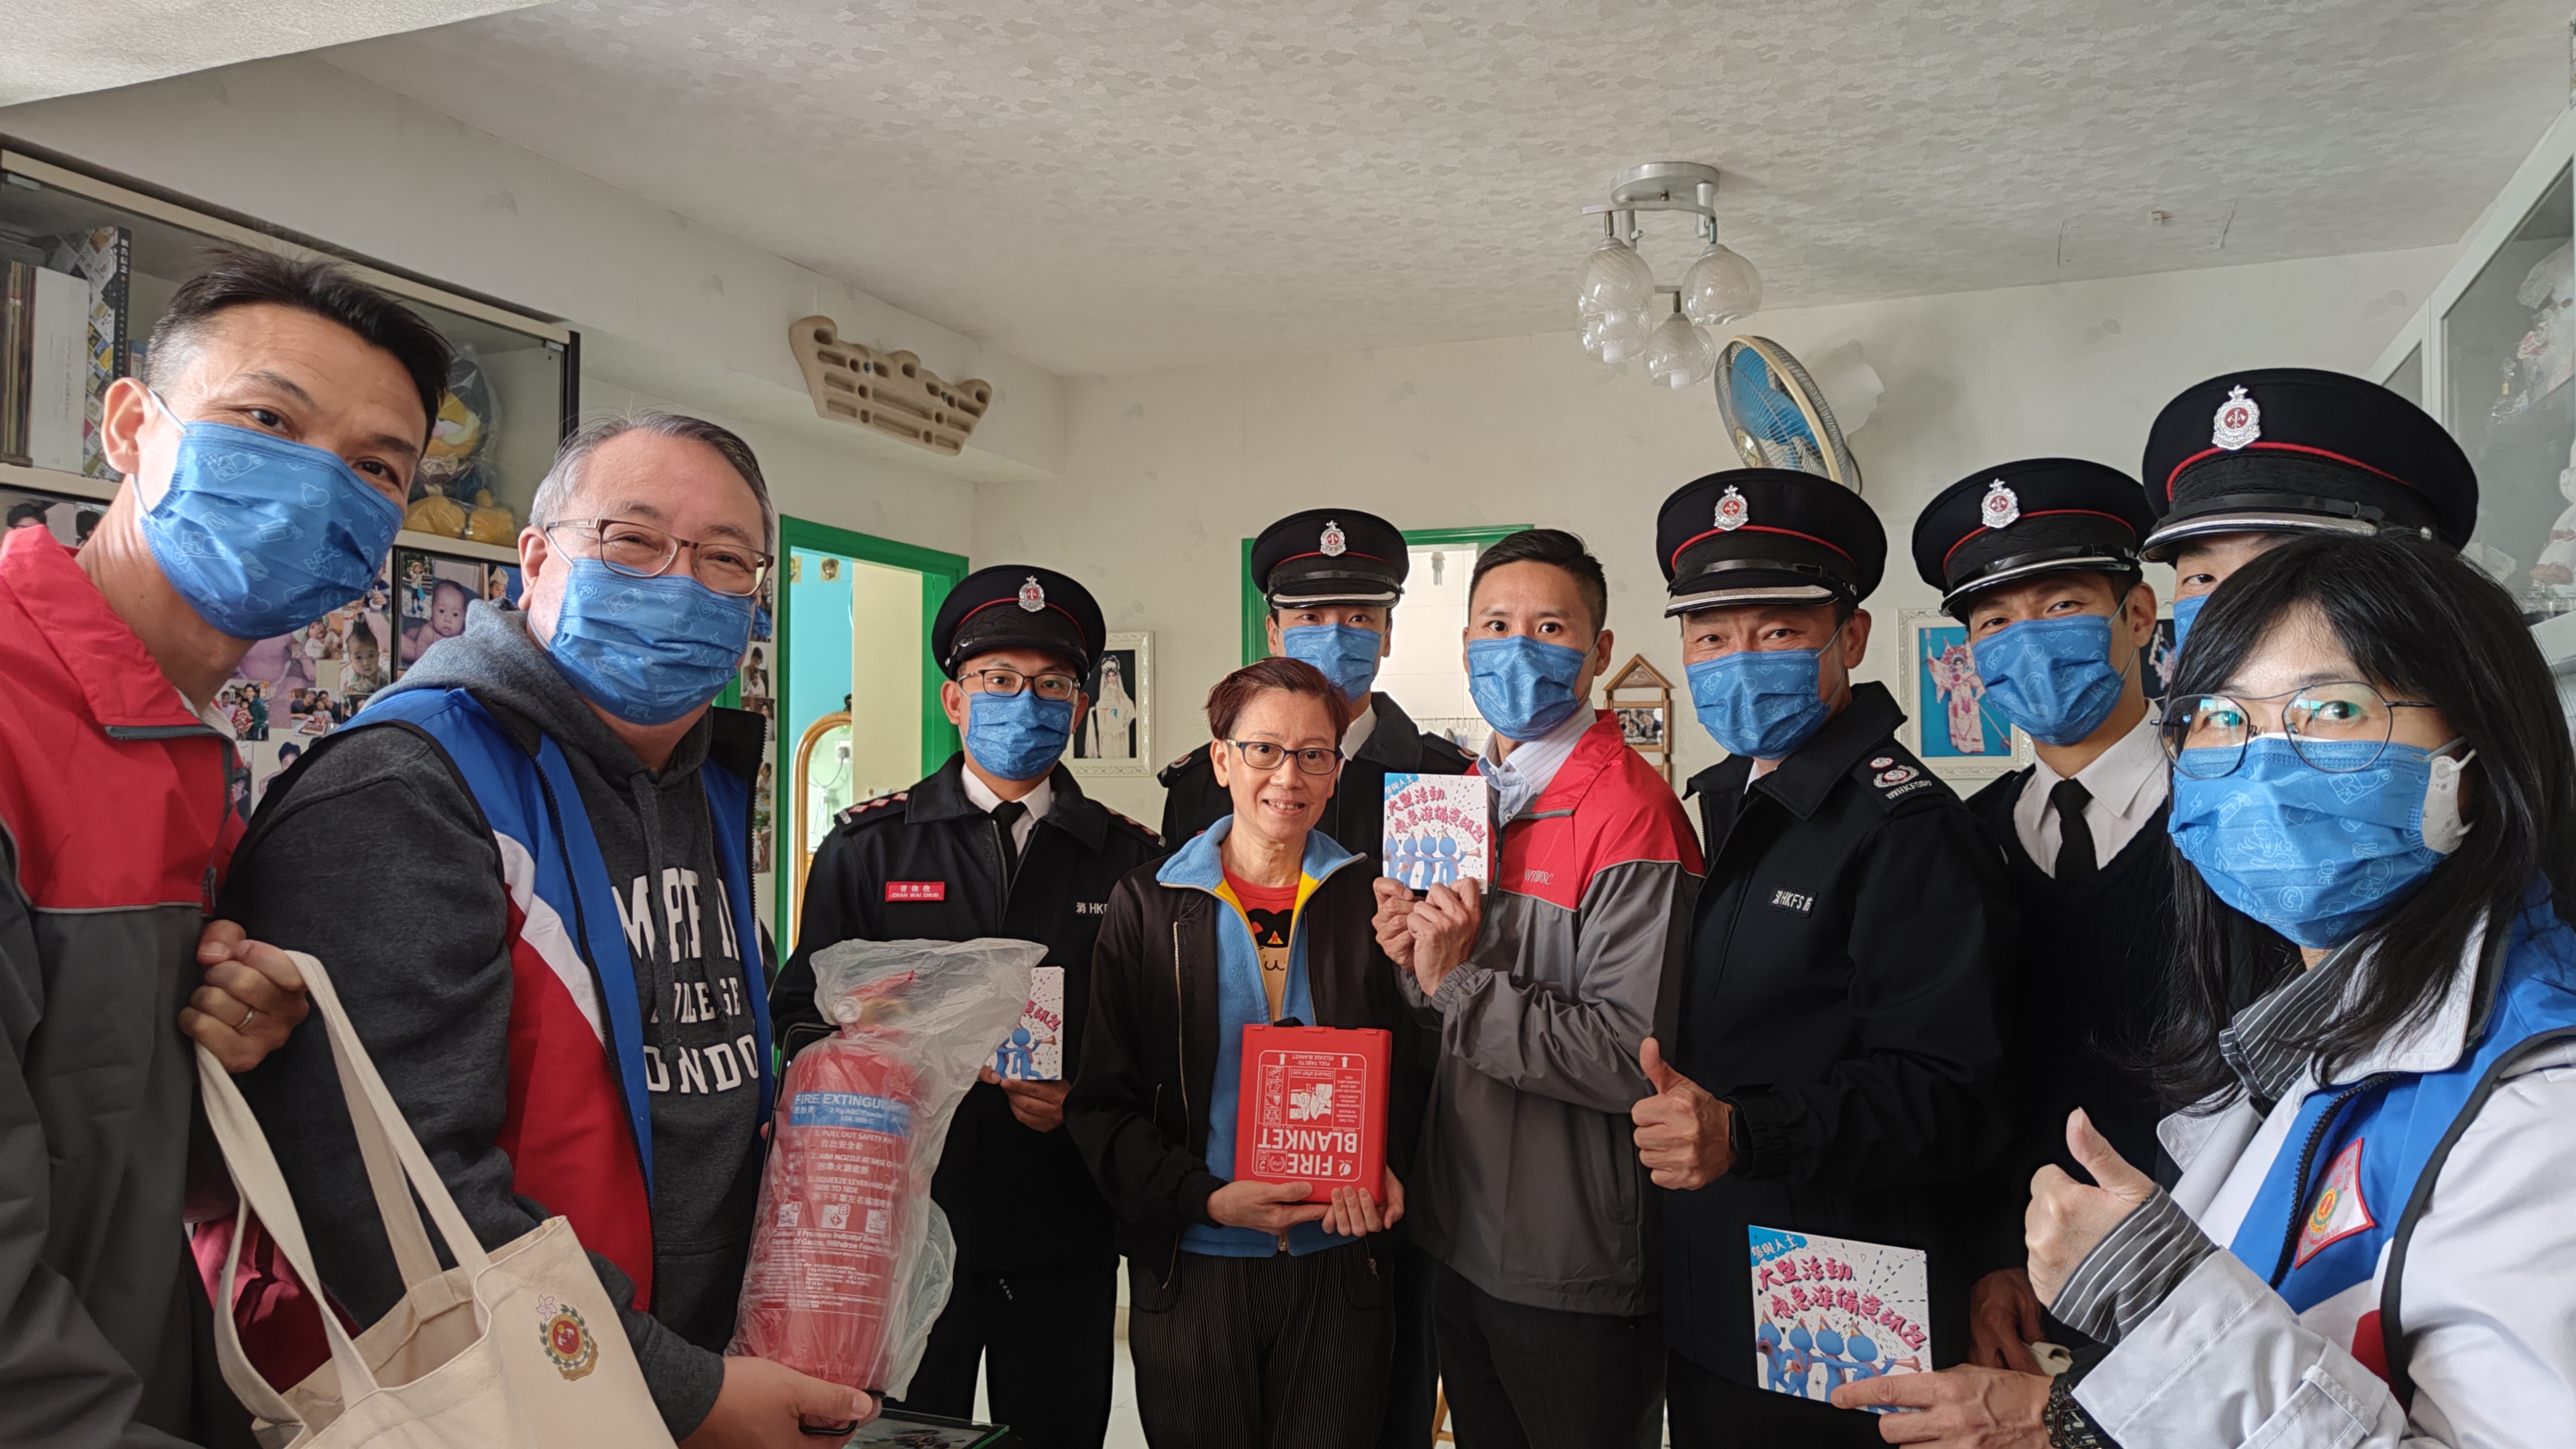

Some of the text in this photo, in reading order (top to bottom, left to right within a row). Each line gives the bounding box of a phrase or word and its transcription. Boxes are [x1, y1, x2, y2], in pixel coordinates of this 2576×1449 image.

[1388, 786, 1445, 816] 大型活動
[1089, 902, 1108, 914] HK
[795, 1094, 820, 1105] FIRE
[858, 1133, 883, 1142] SAFETY
[1258, 1128, 1358, 1153] BLANKET
[835, 1153, 860, 1162] NOZZLE
[1287, 1153, 1333, 1176] FIRE
[840, 1206, 847, 1214] B
[833, 1233, 862, 1241] Indicator
[1751, 1234, 1799, 1260] 參與人士
[1758, 1255, 1853, 1291] 大型活動
[1770, 1285, 1928, 1350] 應急準備資訊包
